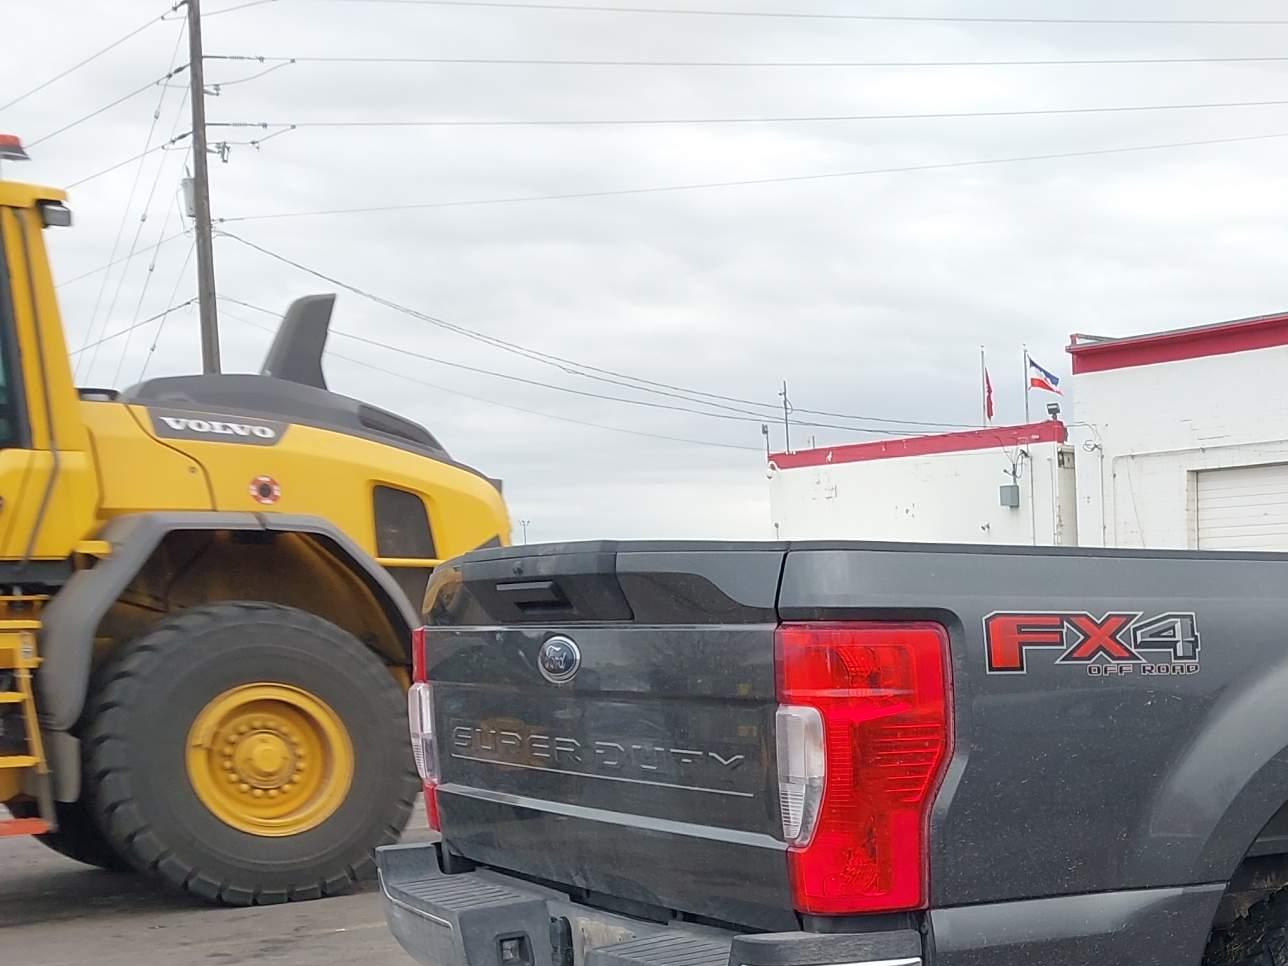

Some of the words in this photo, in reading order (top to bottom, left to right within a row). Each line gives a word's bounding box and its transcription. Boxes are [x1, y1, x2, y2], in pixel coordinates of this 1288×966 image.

[158, 415, 276, 438] VOLVO
[983, 610, 1200, 675] FX4
[1087, 663, 1133, 676] OFF
[1141, 663, 1200, 676] ROAD
[452, 725, 583, 762] SUPER
[593, 740, 746, 773] DUTY
